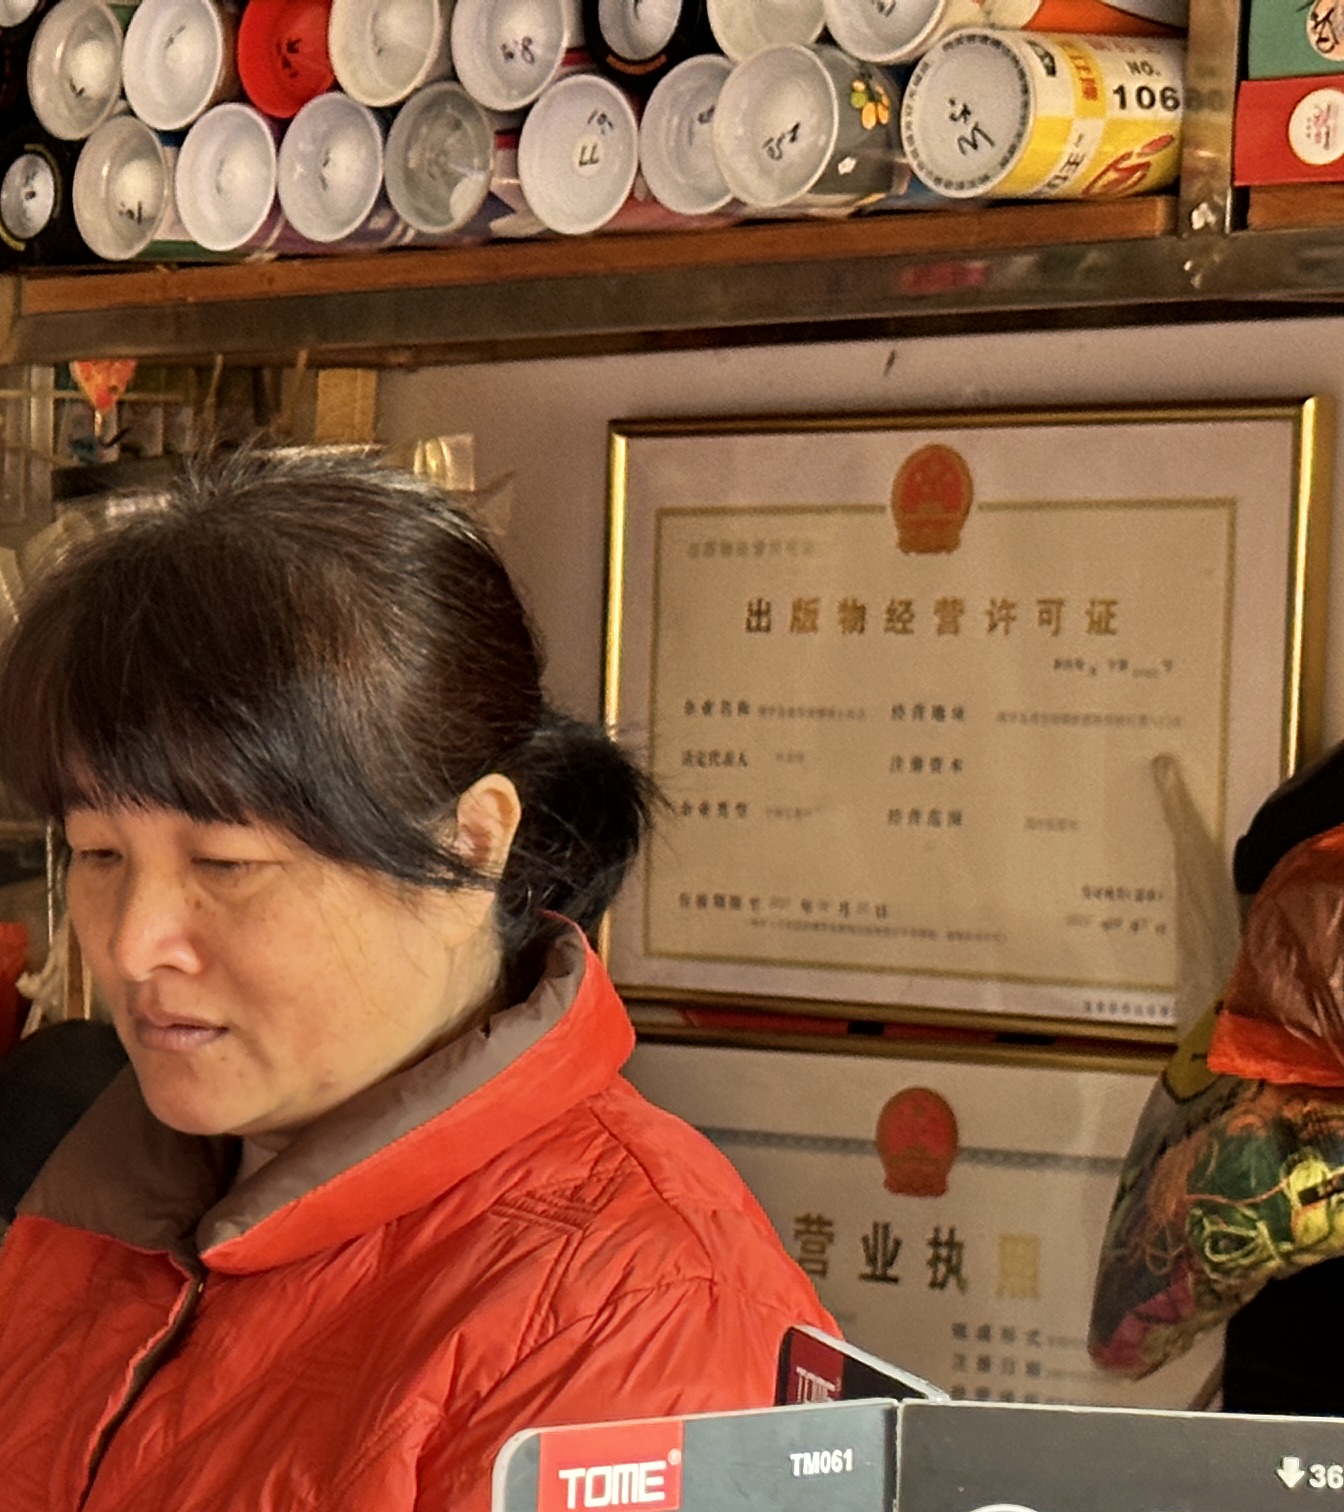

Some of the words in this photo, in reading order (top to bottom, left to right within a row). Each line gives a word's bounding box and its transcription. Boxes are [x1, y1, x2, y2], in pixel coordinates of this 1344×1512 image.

[1110, 83, 1181, 112] 106
[745, 597, 1119, 636] 出版物经营许可证
[789, 1449, 854, 1477] TM061
[558, 1458, 668, 1509] TOME
